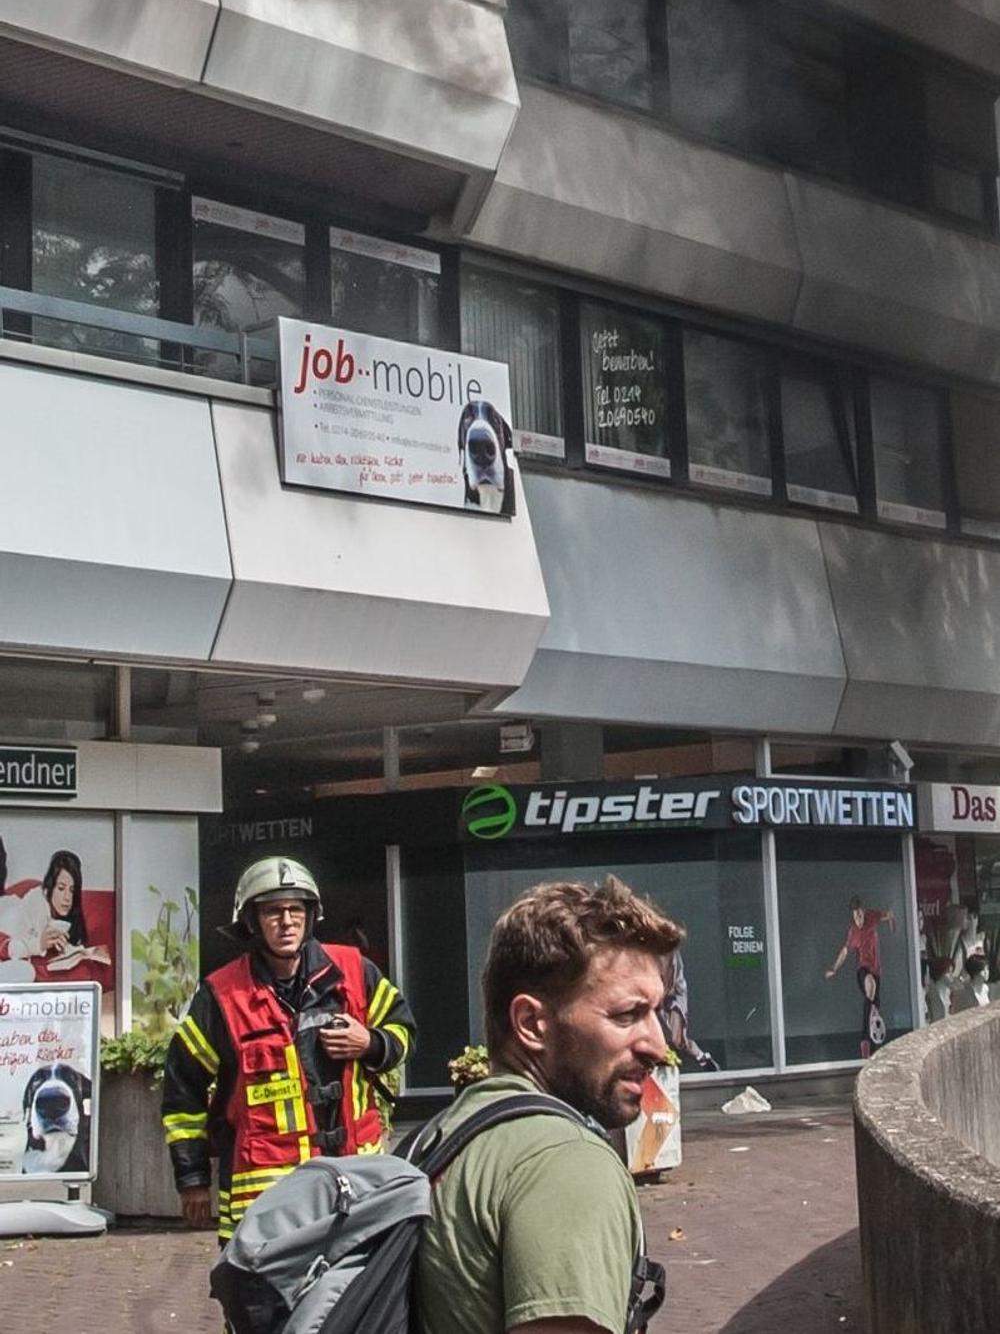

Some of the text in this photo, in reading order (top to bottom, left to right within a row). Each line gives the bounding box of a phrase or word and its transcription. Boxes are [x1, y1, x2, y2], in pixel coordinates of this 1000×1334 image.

[602, 350, 655, 372] bewerben!
[613, 386, 642, 404] 0214
[524, 785, 915, 833] tipster SPORTWETTEN
[951, 786, 996, 823] Das
[728, 926, 755, 938] FOLGE
[733, 941, 764, 953] DEINEM
